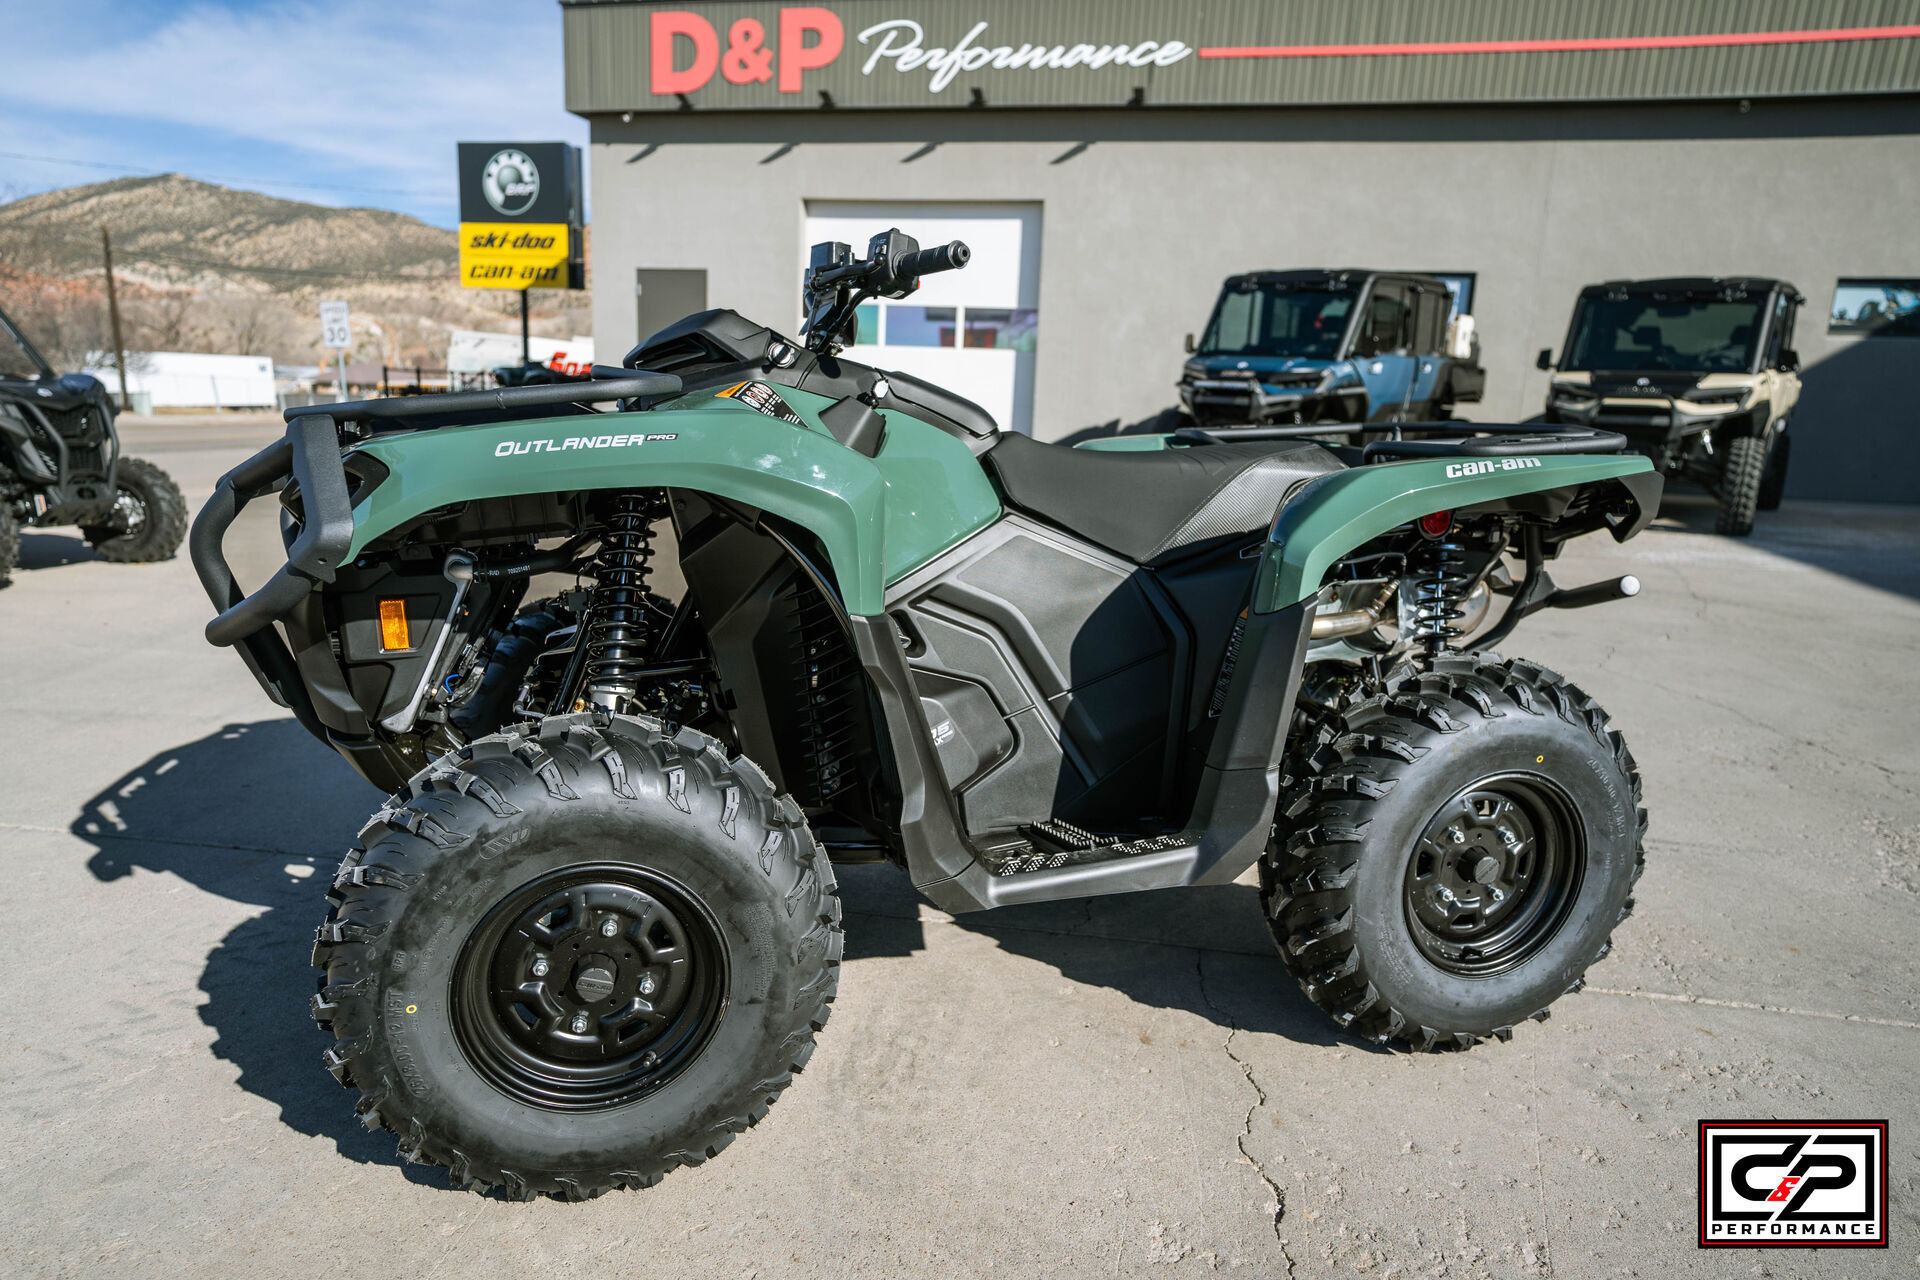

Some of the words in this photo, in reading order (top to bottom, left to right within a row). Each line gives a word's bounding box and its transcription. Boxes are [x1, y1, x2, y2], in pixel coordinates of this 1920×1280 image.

[650, 7, 845, 95] D&P
[857, 19, 1193, 92] Performance
[494, 434, 645, 457] OUTLANDER
[646, 433, 677, 441] PRO
[1446, 457, 1542, 479] can-am
